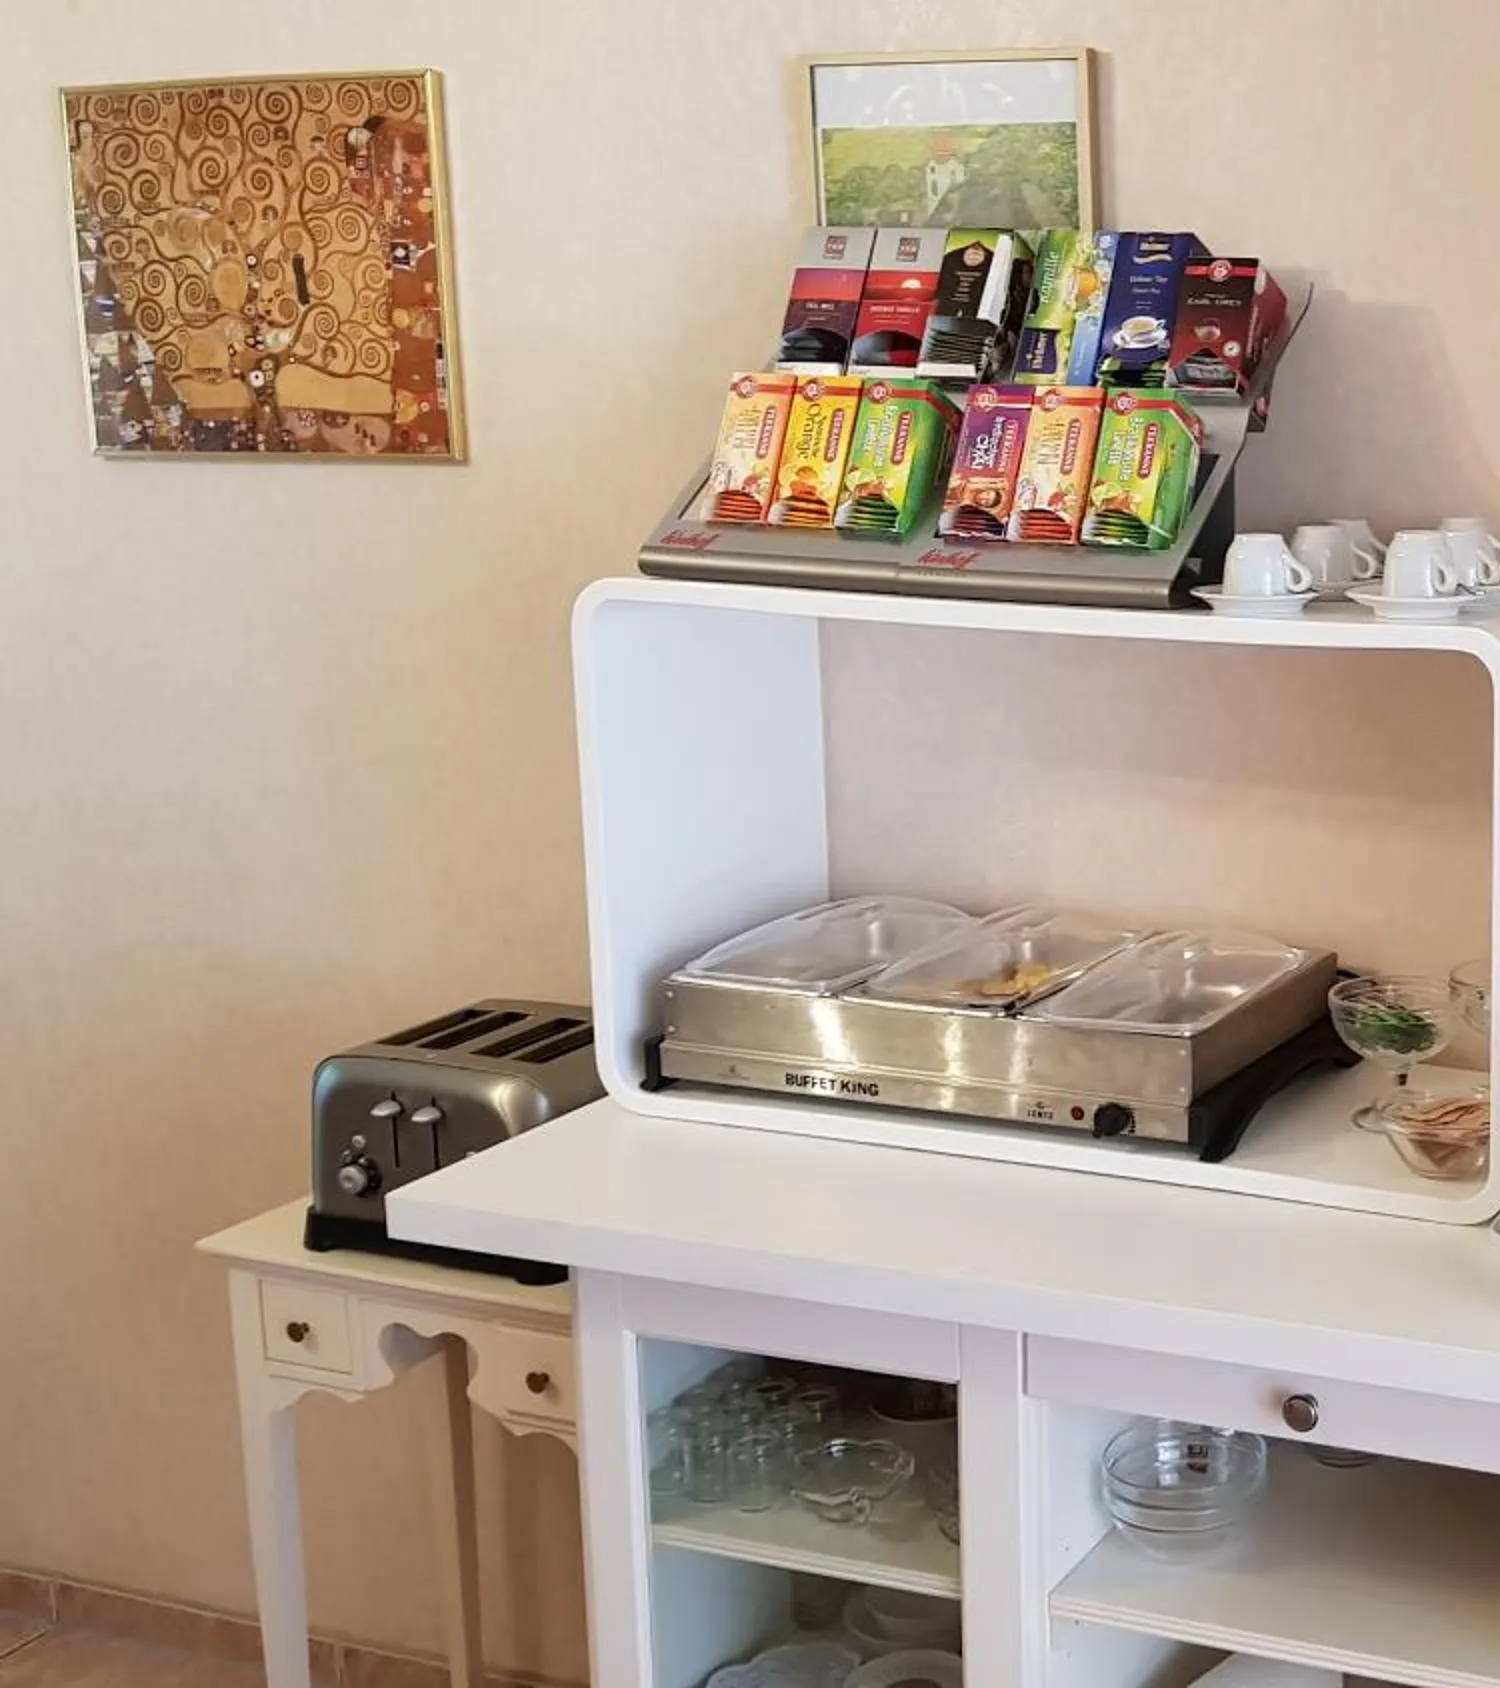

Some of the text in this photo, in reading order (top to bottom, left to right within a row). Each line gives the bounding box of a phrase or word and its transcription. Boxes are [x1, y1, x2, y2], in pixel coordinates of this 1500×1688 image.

[796, 403, 823, 460] Orange
[785, 1072, 880, 1098] BUFFET KING
